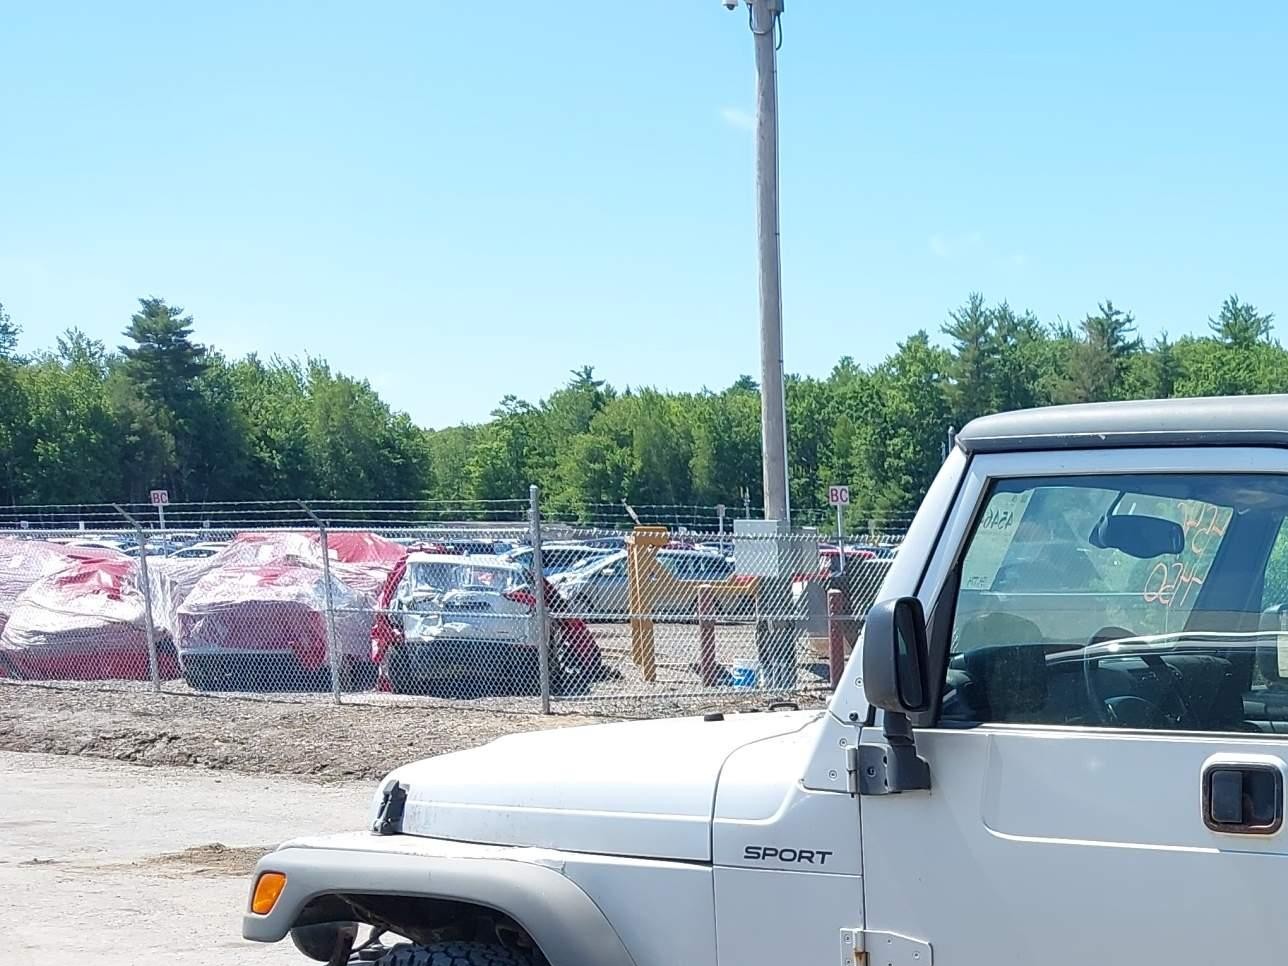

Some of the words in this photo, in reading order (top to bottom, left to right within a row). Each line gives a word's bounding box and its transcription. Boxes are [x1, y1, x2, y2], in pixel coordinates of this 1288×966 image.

[152, 492, 168, 504] BC
[829, 487, 849, 503] BC
[743, 845, 833, 866] SPORT
